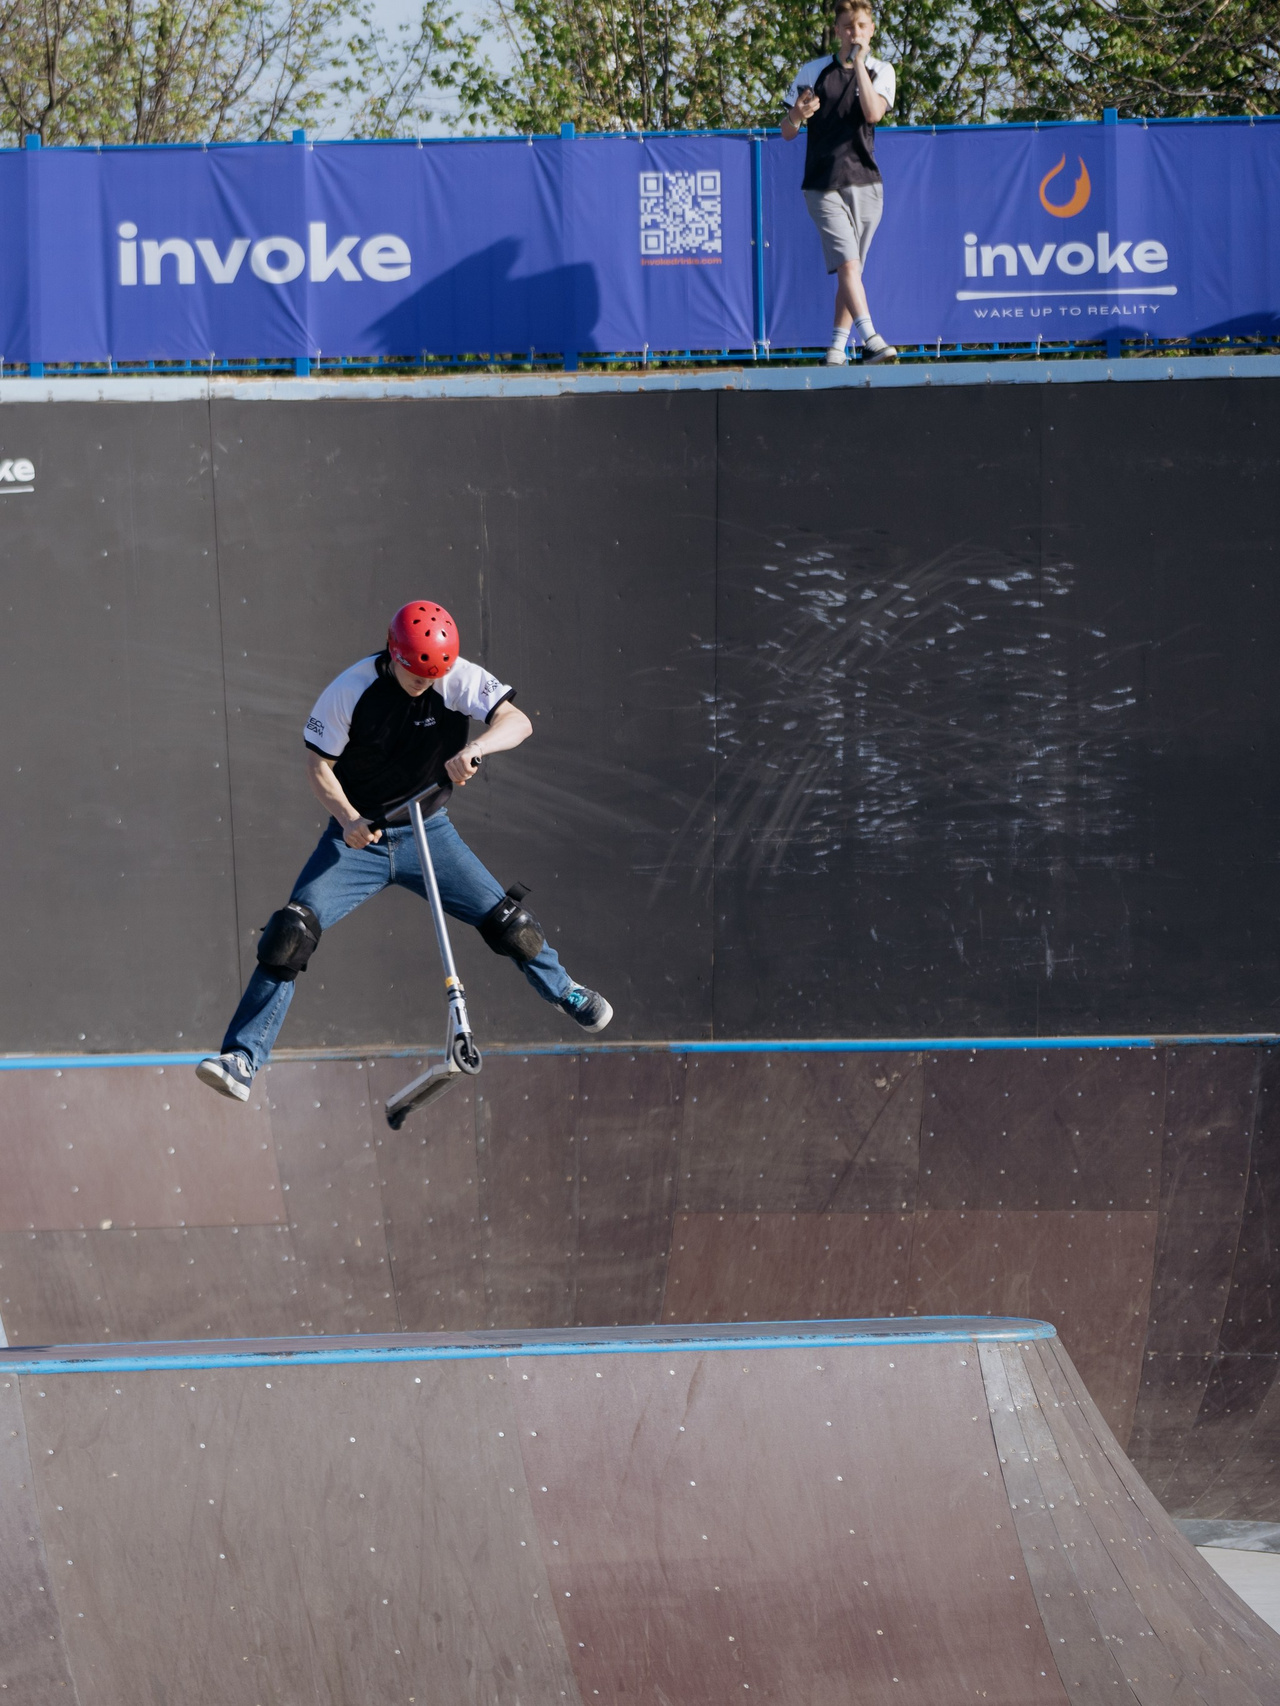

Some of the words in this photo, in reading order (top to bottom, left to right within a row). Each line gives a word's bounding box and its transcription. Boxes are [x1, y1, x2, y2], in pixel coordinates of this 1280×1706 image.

[118, 221, 412, 286] invoke
[964, 231, 1168, 277] invoke
[974, 309, 1024, 318] WAKE
[1031, 308, 1053, 317] UP
[1059, 306, 1082, 316] TO
[1088, 304, 1161, 315] REALITY
